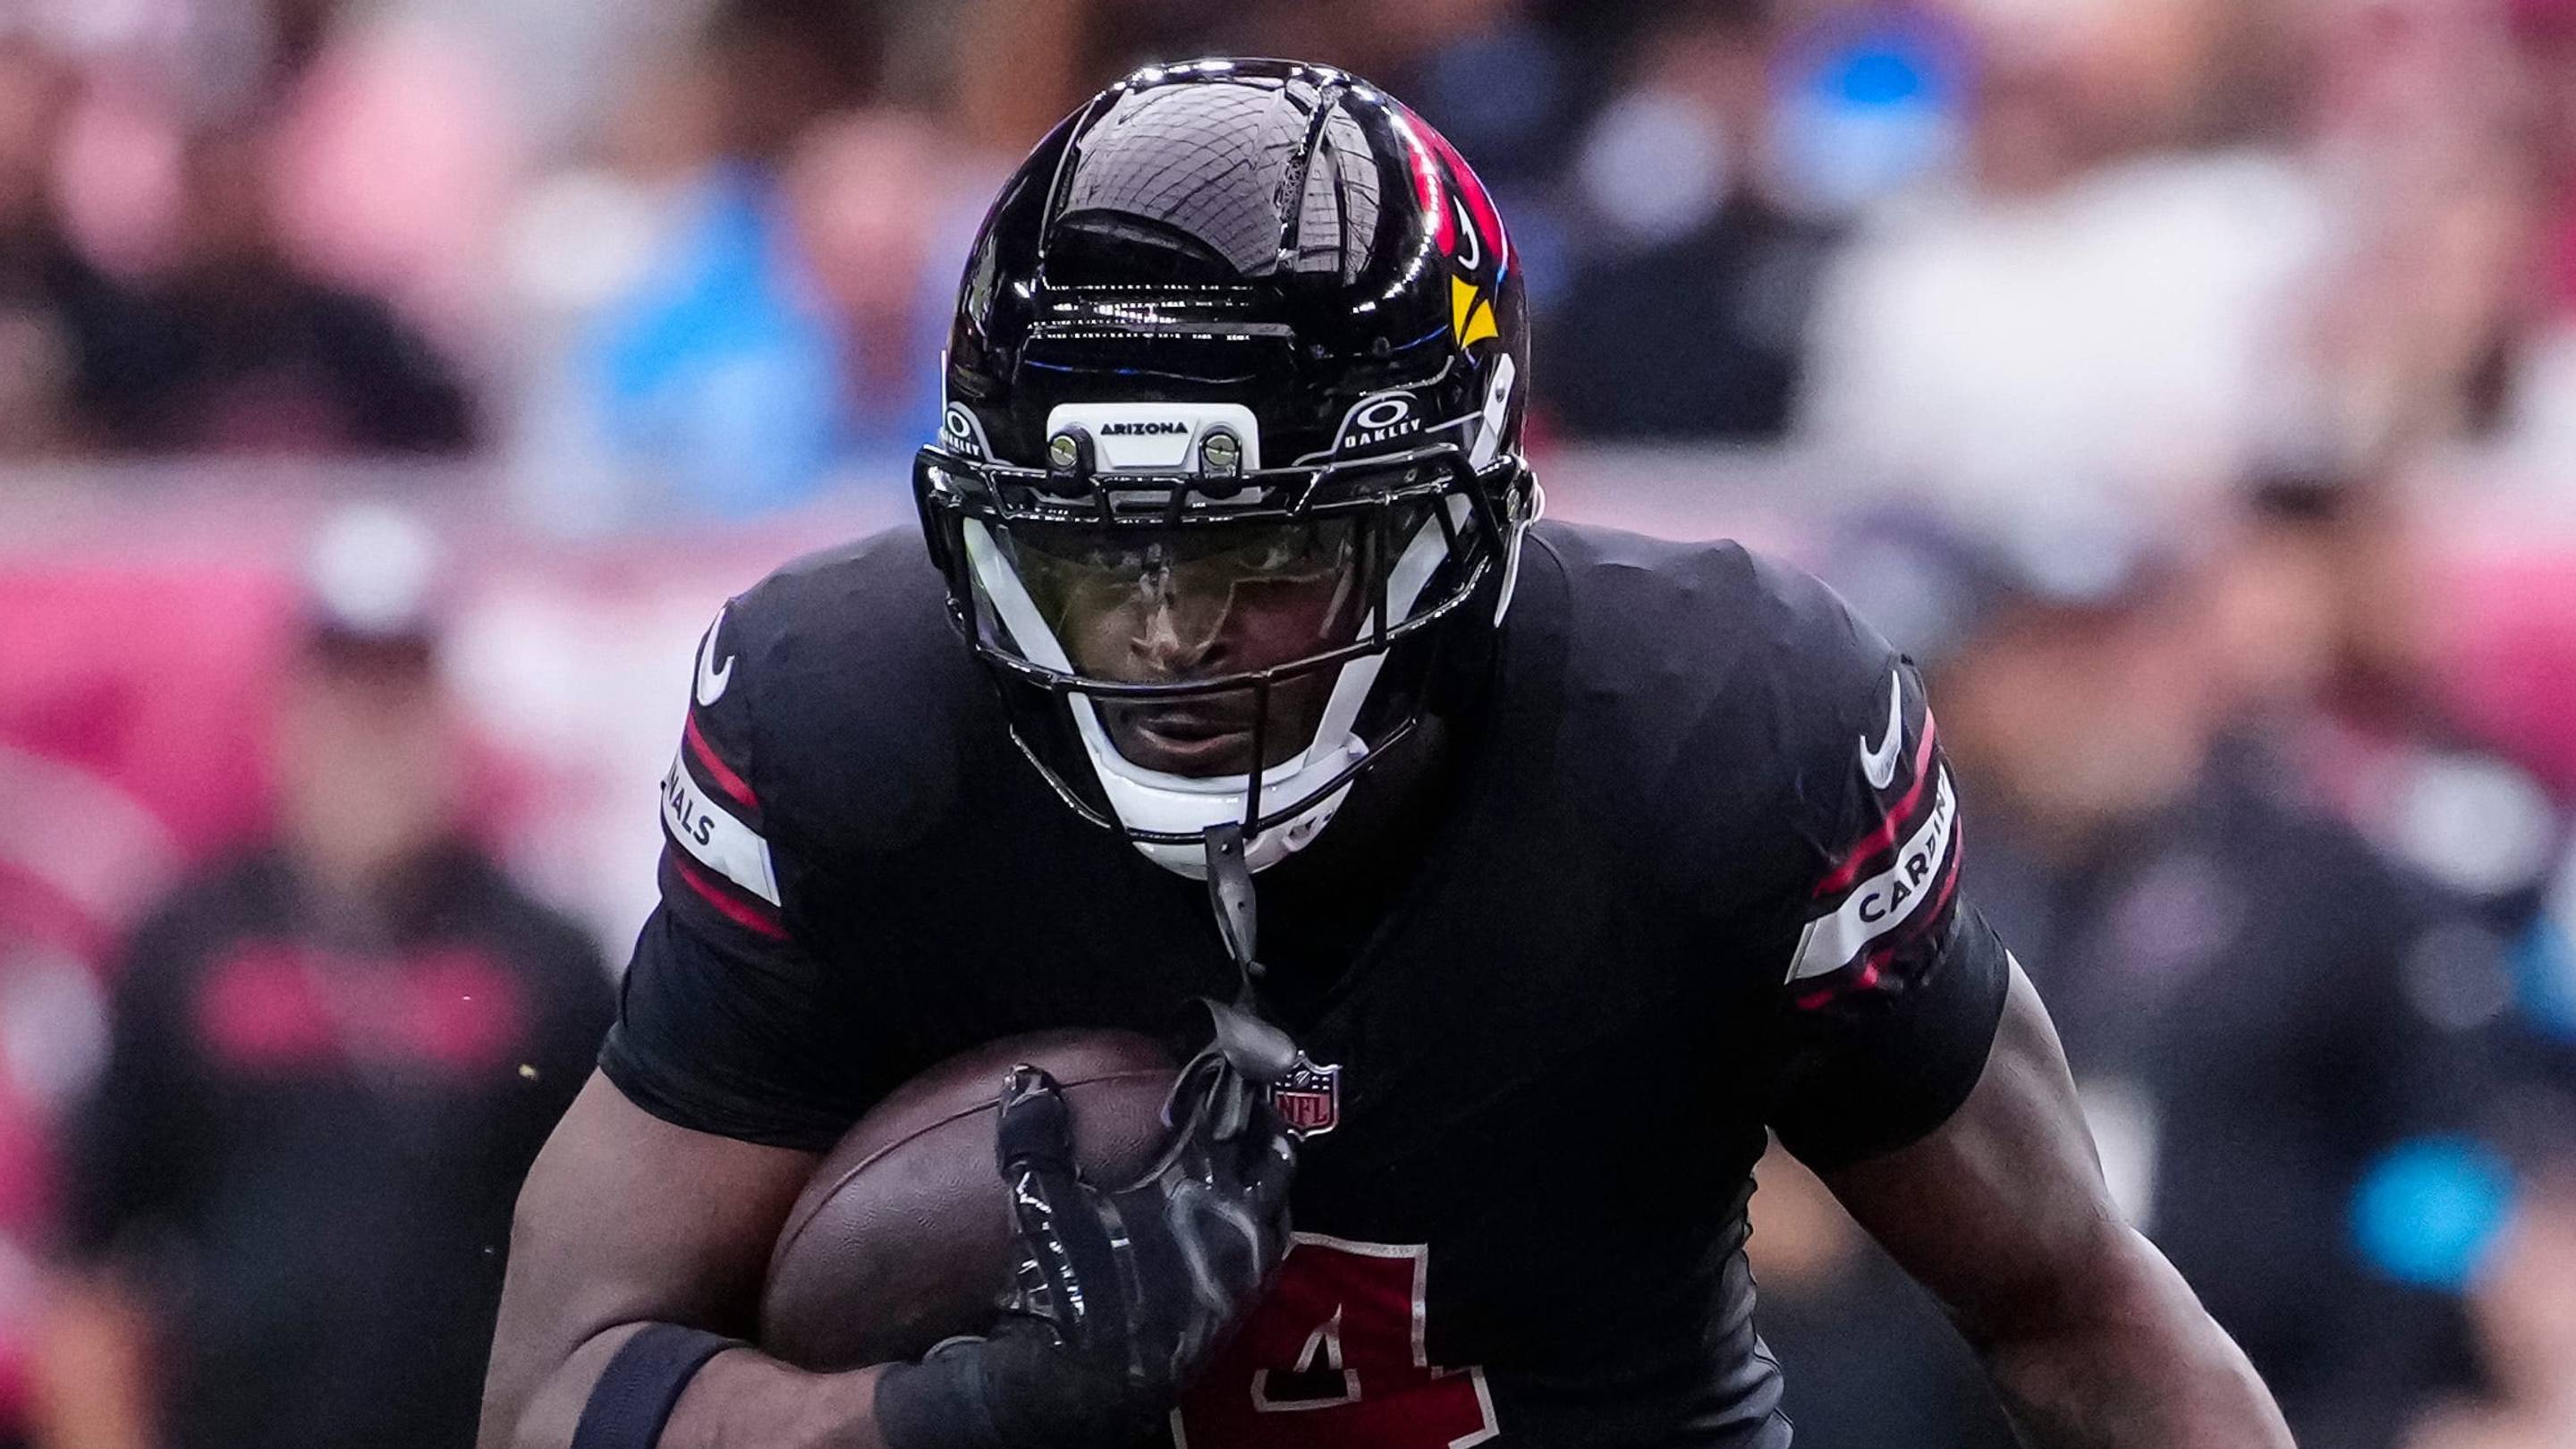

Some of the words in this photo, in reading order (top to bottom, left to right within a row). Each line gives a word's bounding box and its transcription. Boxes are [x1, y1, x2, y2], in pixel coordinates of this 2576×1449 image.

[1099, 421, 1189, 436] ARIZONA
[1344, 418, 1420, 448] OAKLEY
[1276, 1093, 1329, 1126] NFL
[1169, 1230, 1500, 1449] 4
